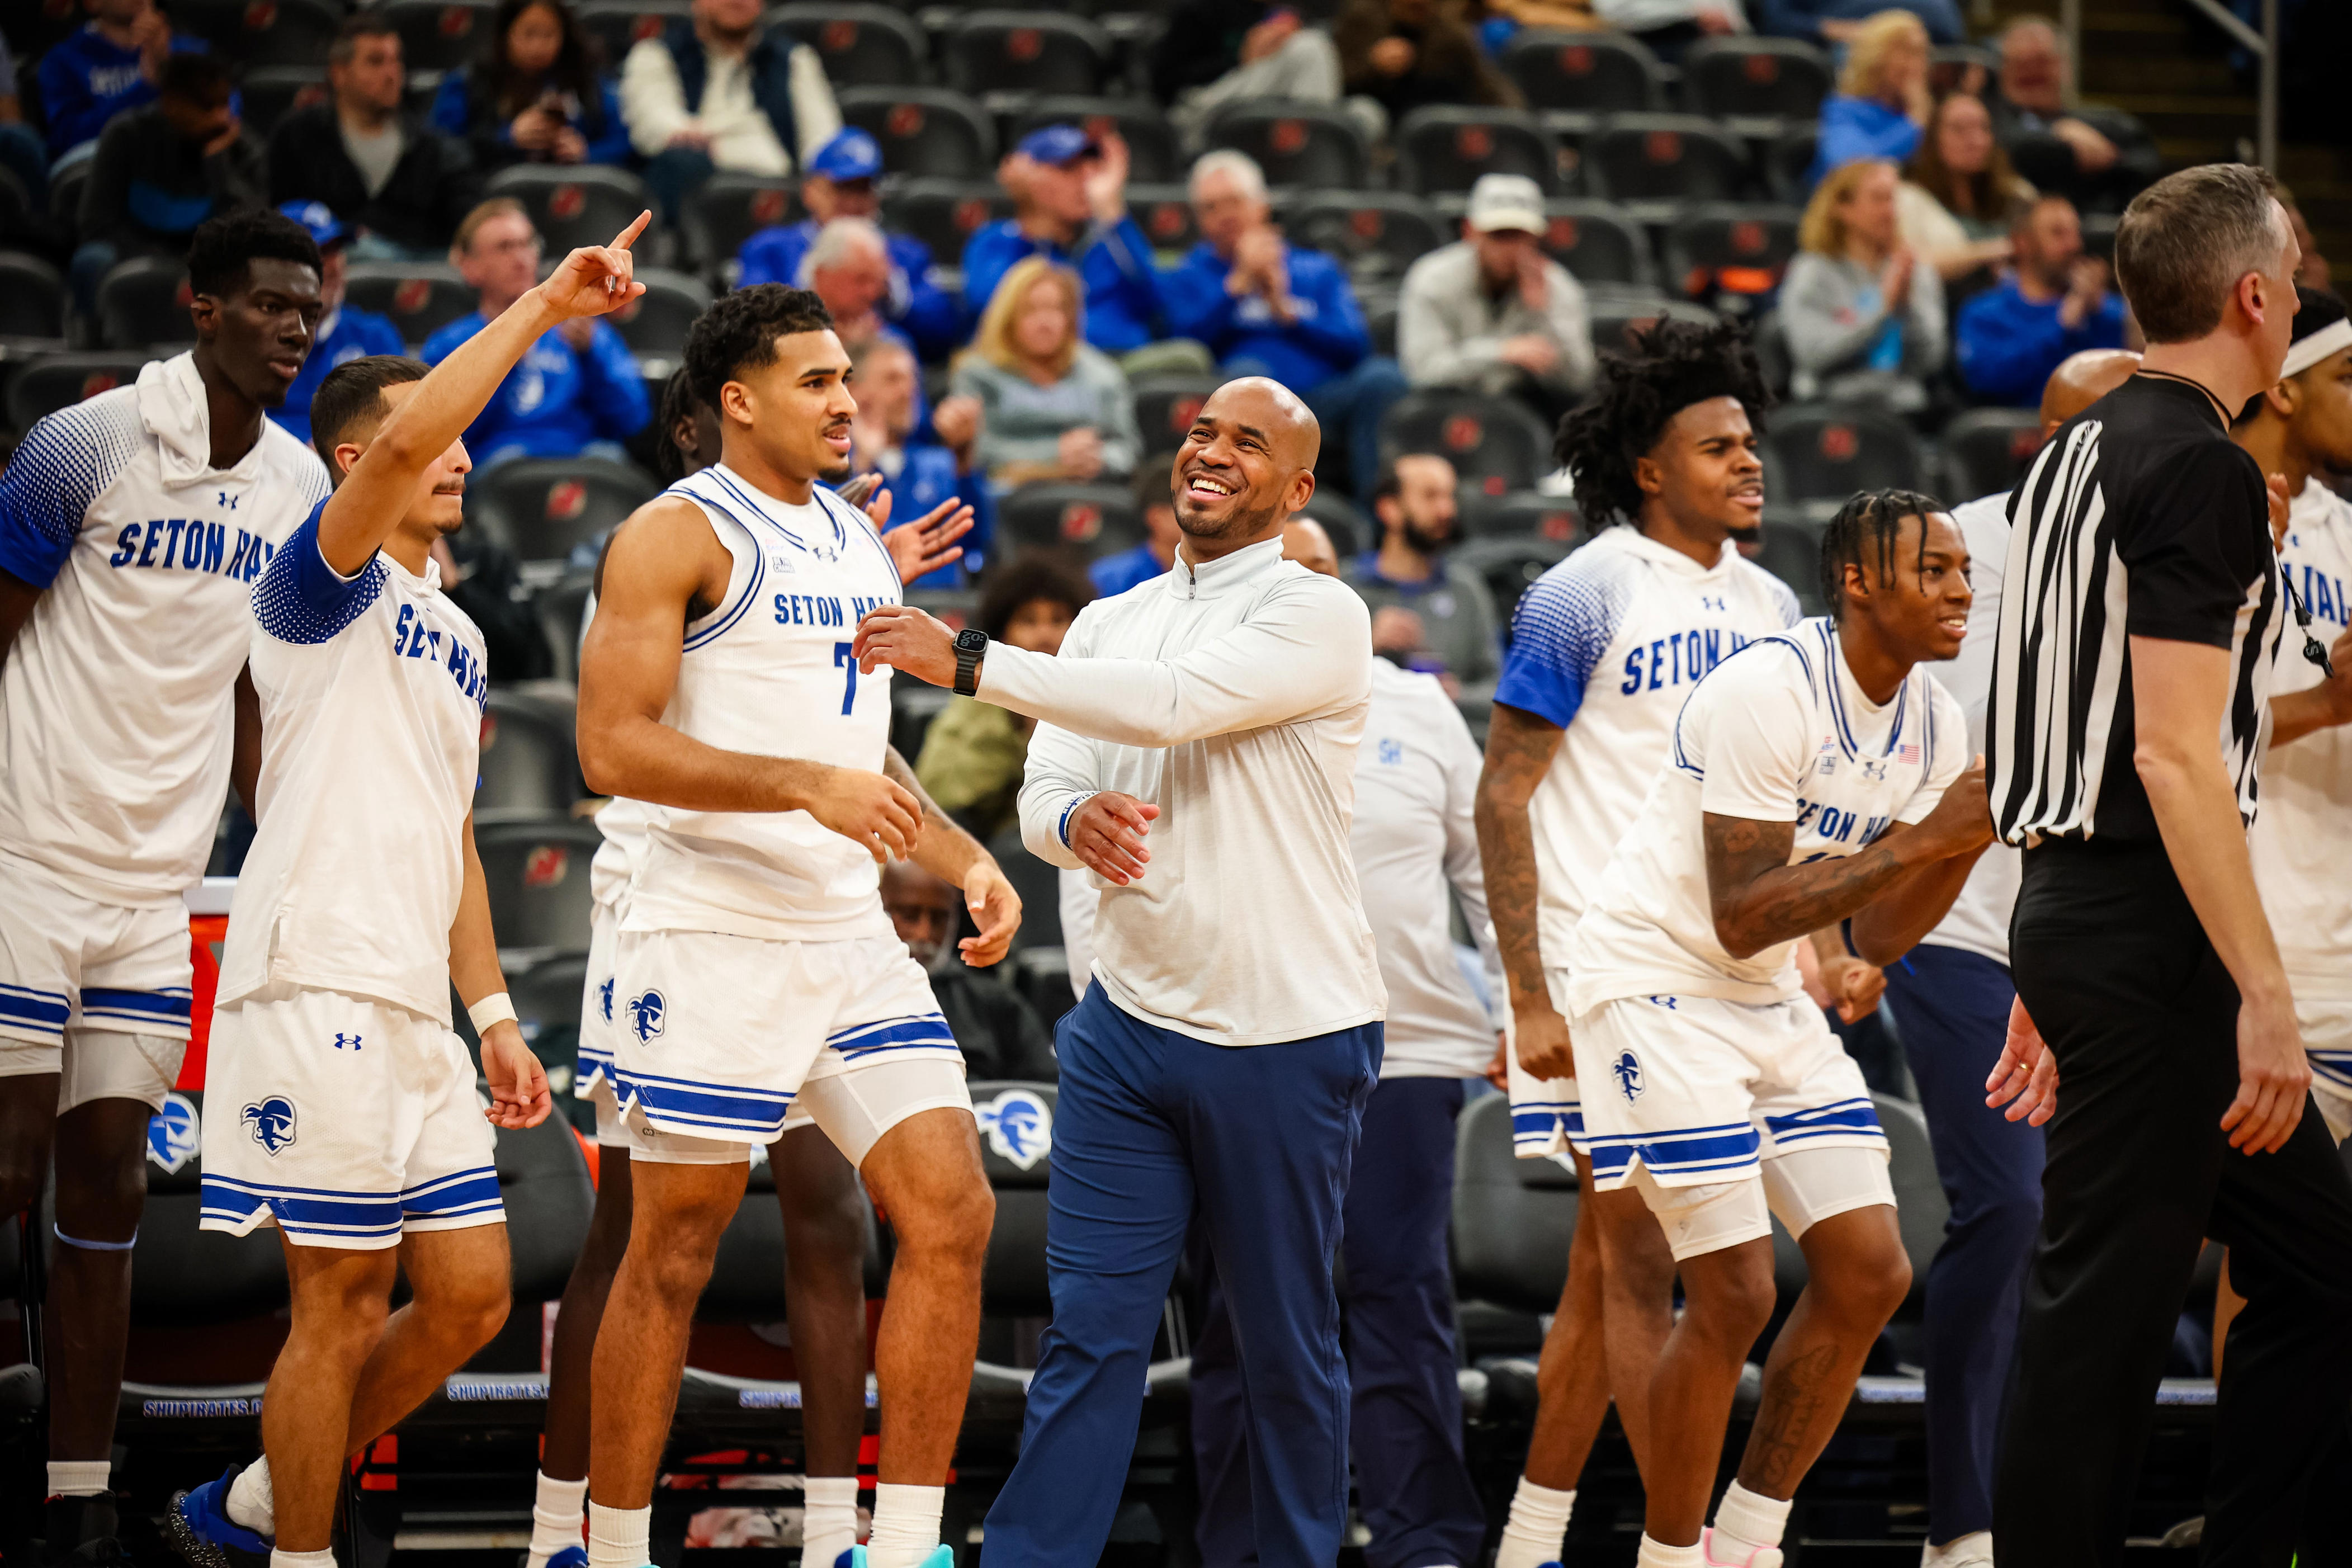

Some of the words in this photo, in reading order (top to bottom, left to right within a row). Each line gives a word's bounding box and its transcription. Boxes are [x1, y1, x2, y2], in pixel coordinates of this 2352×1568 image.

[110, 518, 225, 574] SETON
[224, 527, 275, 584] HA
[774, 593, 843, 627] SETON
[834, 641, 857, 716] 7
[1620, 628, 1719, 695] SETON
[143, 1398, 263, 1419] SHUPIRATES.C
[447, 1382, 550, 1402] SHUPIRATES.
